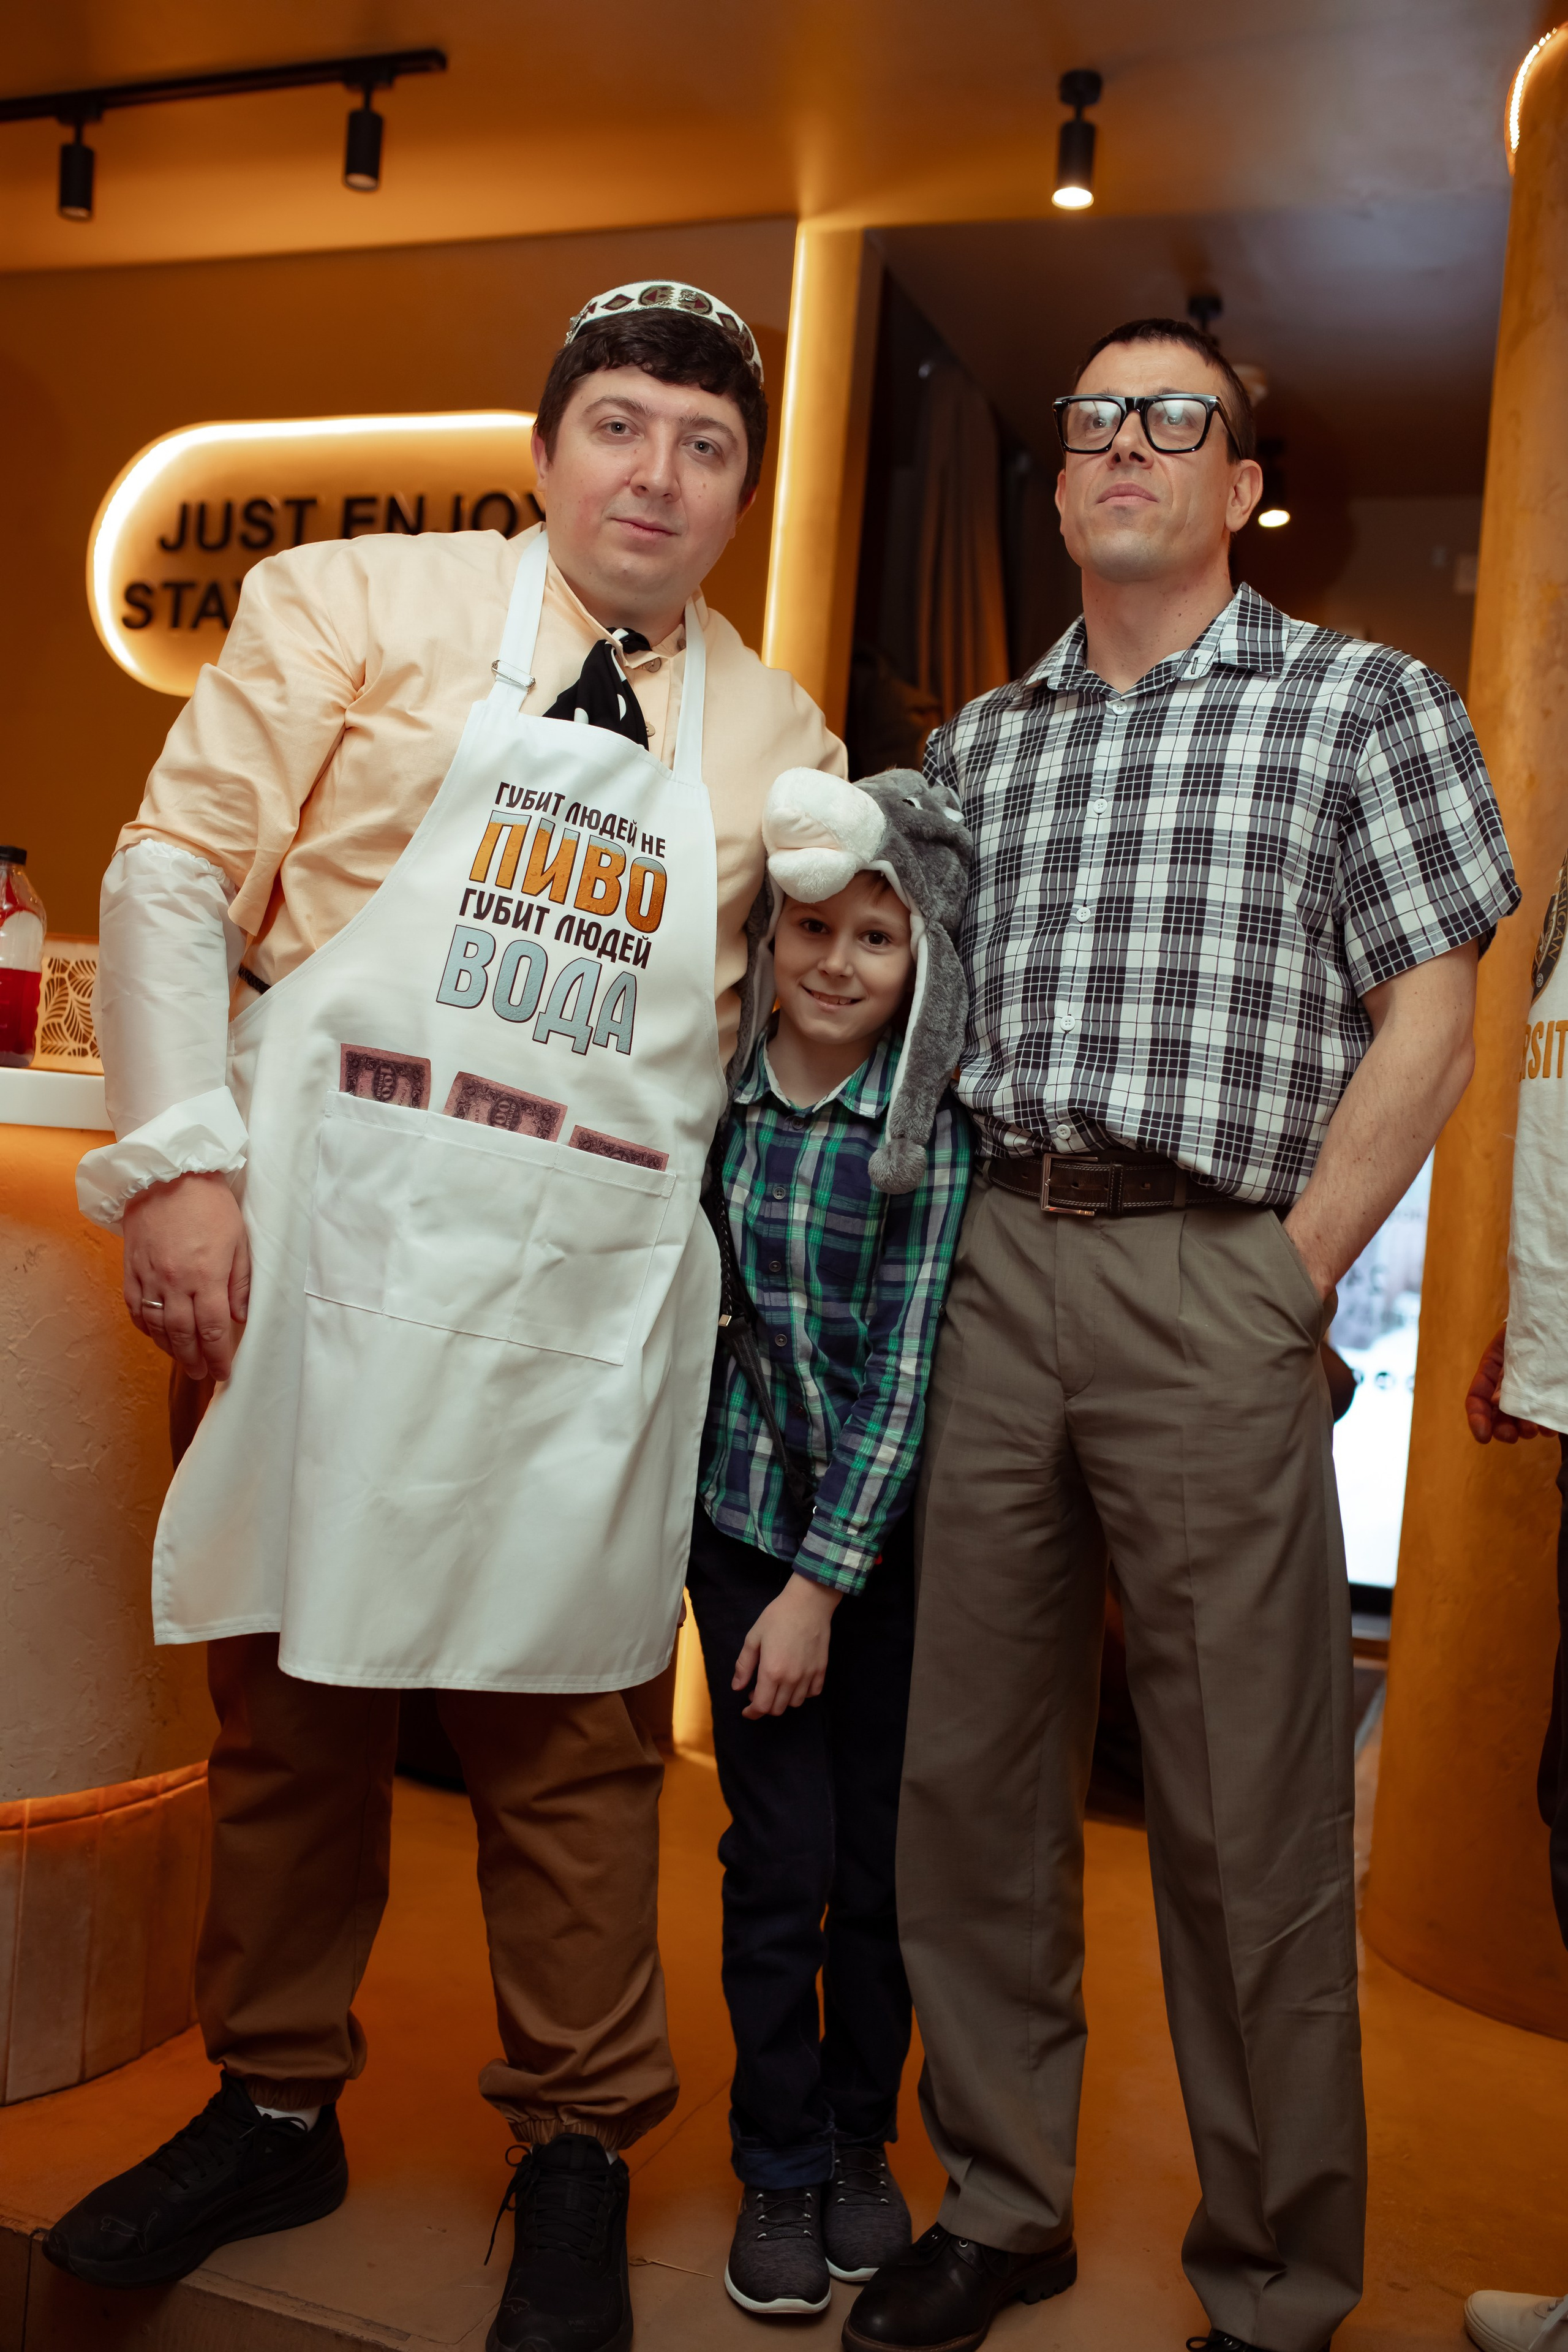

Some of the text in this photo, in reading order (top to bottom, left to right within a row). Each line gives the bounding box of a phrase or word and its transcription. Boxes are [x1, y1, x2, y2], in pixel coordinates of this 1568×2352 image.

[157, 497, 318, 552] JUST
[121, 579, 243, 631] STA
[495, 782, 666, 858] ГУБИТ ЛЮДЕЙ НЕ
[469, 810, 668, 933] ПИВО
[459, 888, 652, 969] ГУБИТ ЛЮДЕЙ
[1548, 872, 1567, 962] CHIGAN
[435, 924, 638, 1056] ВОДА
